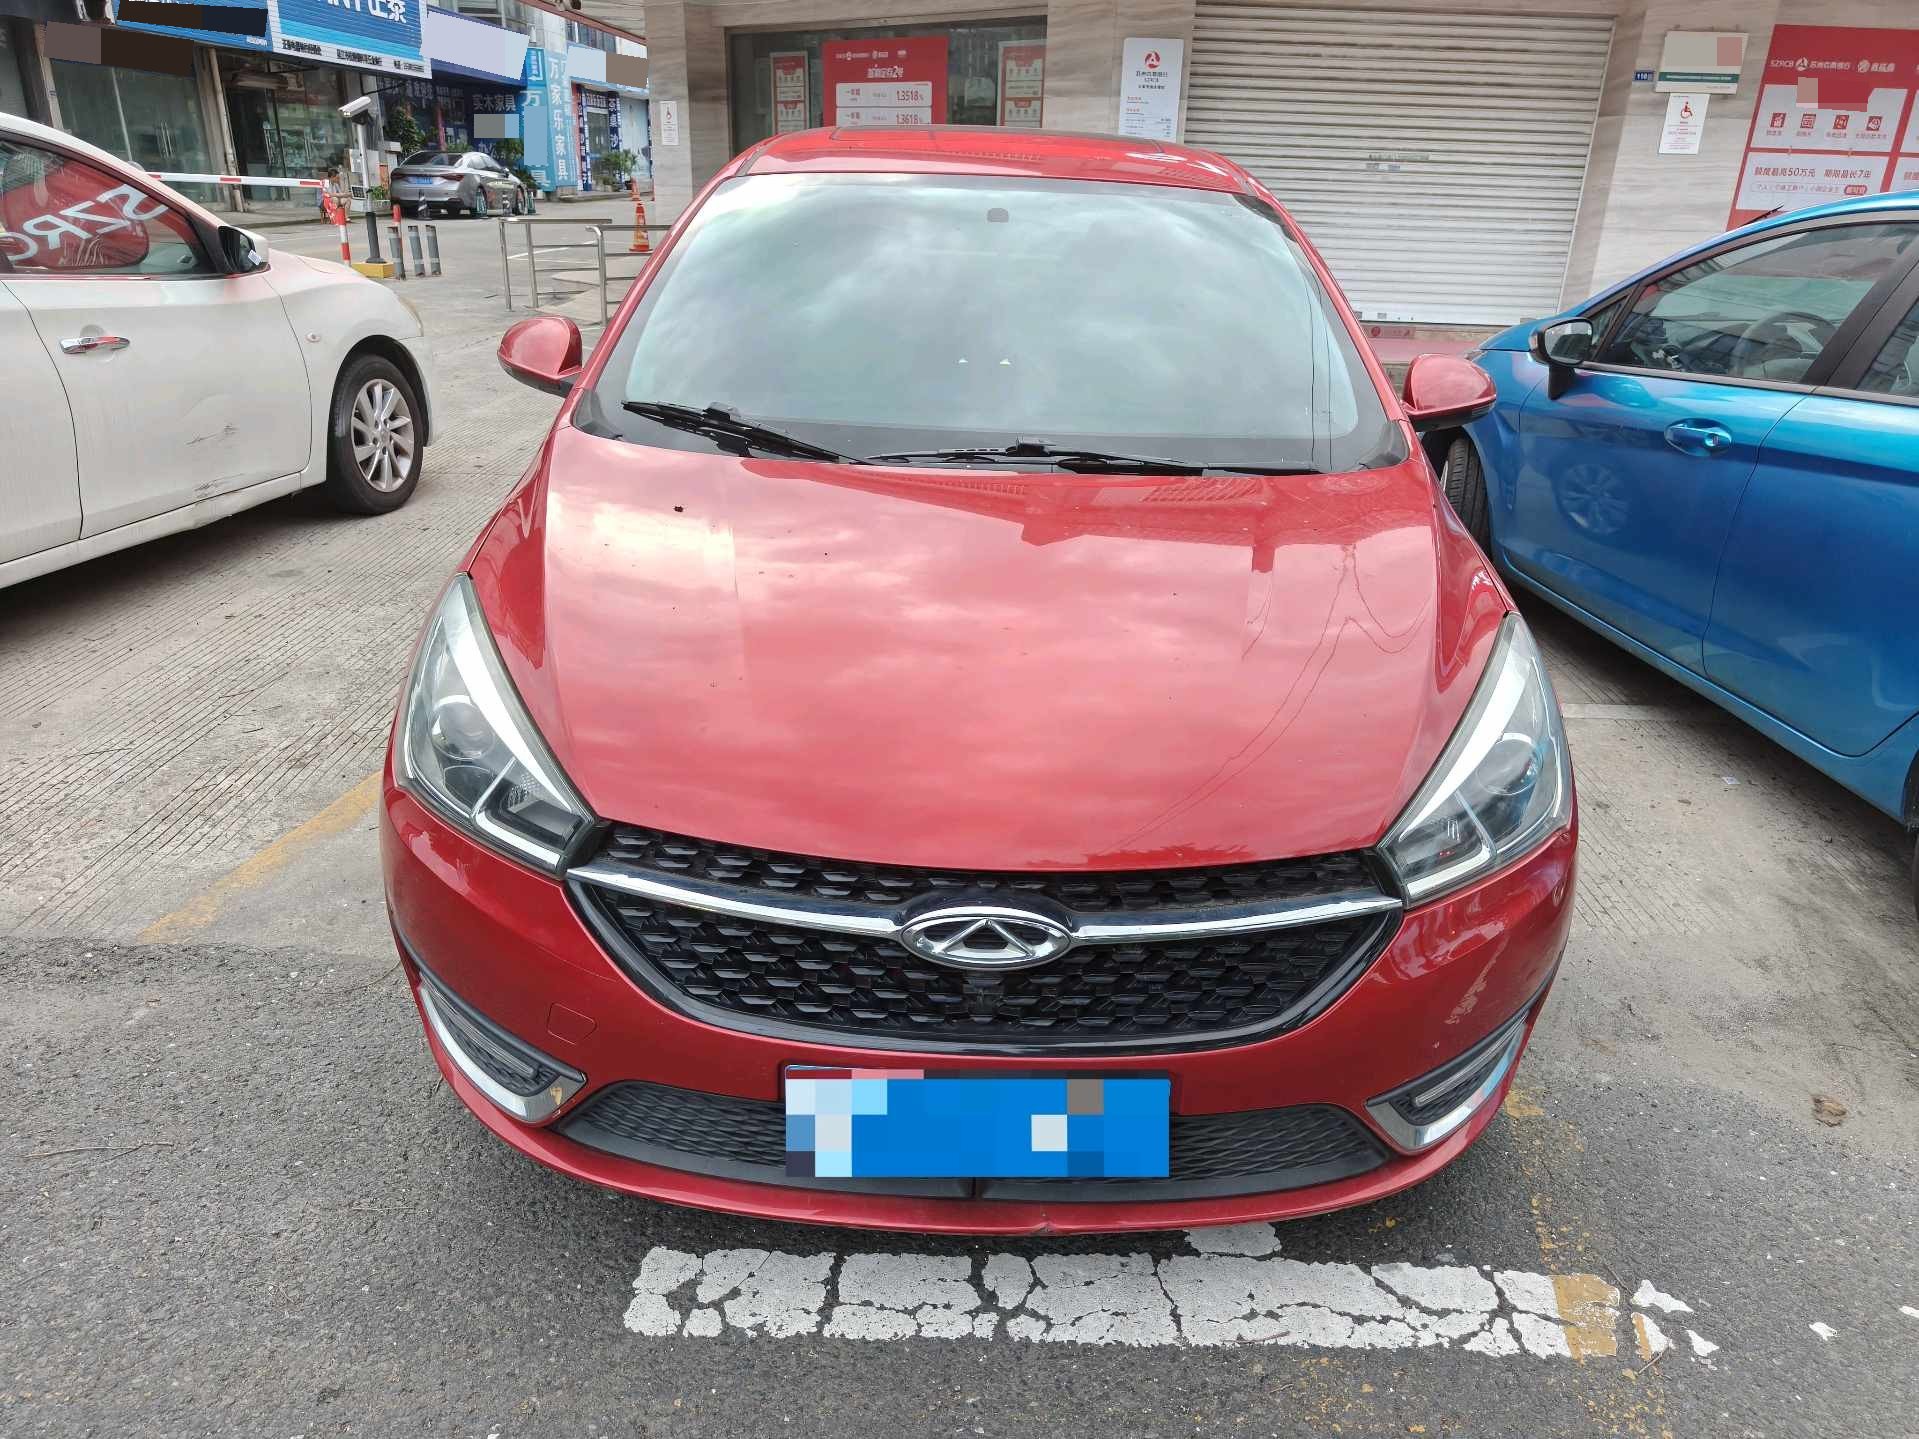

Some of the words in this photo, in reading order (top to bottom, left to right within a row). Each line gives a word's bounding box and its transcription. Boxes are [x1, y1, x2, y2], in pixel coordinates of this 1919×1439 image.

[549, 56, 569, 180] 万家乐家具
